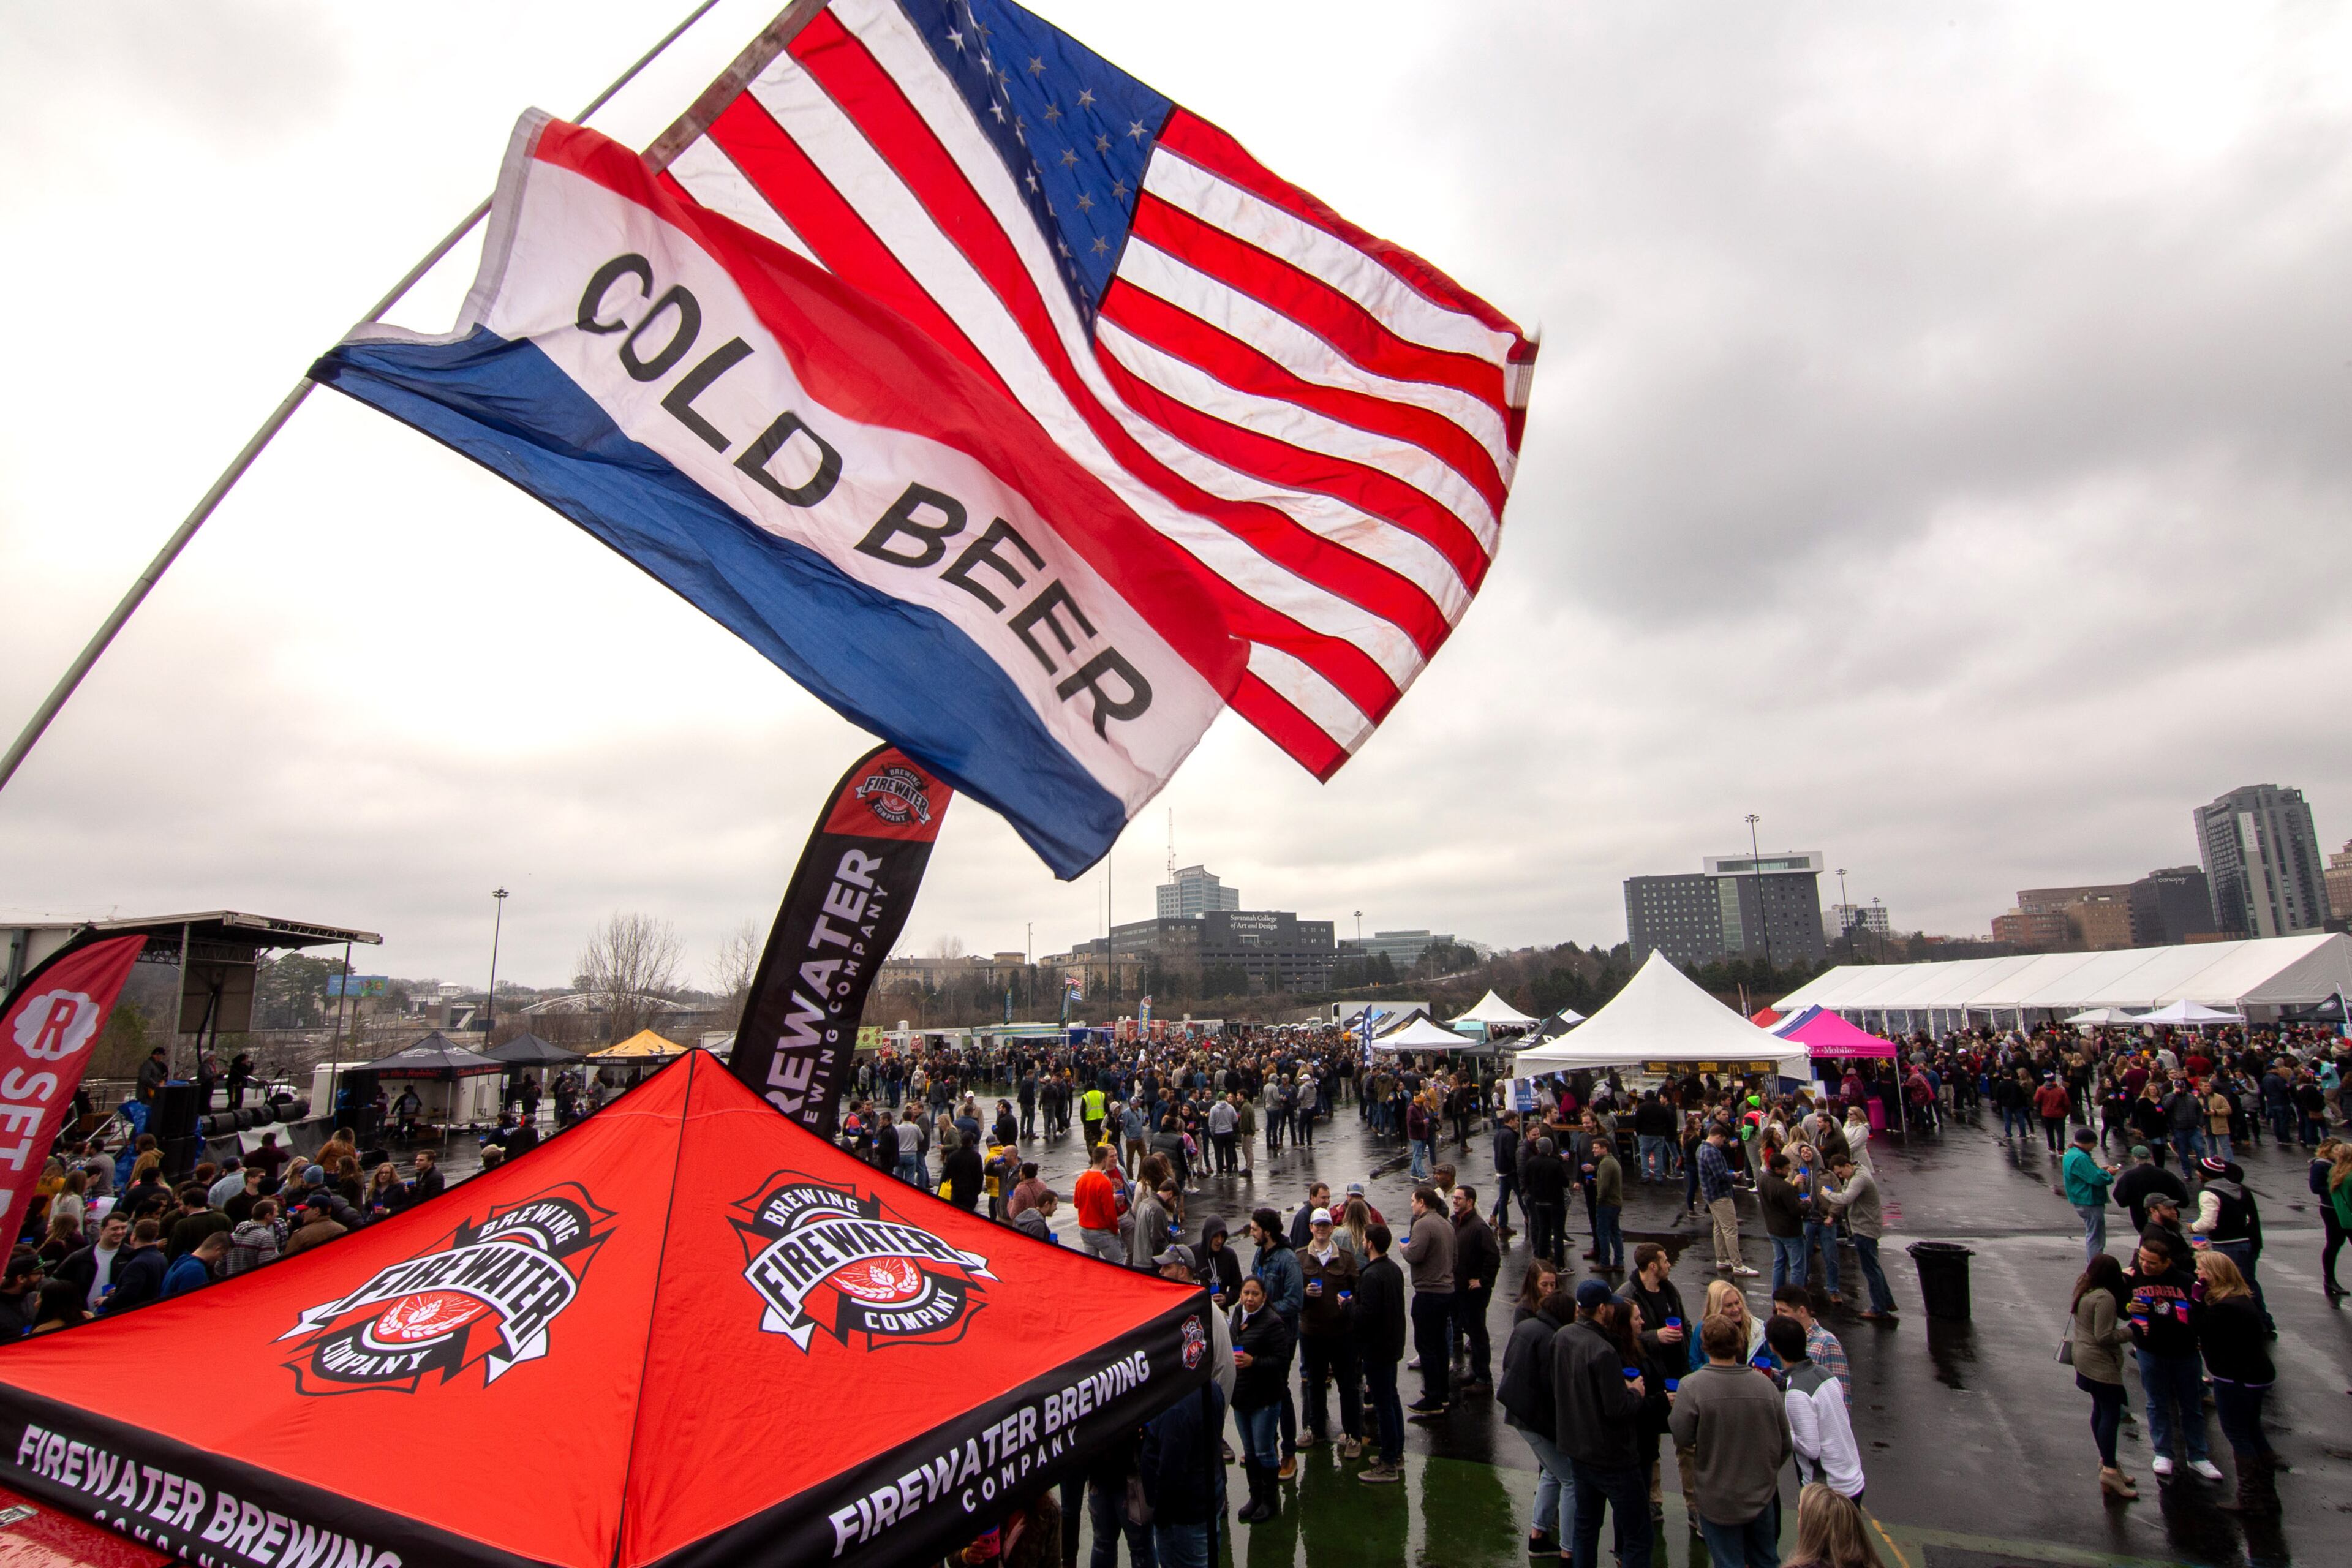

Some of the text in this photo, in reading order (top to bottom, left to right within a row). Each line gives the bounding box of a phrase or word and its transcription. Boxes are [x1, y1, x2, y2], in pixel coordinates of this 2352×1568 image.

[576, 252, 1153, 742] COLD BEER
[864, 777, 927, 815] FIREWATER
[889, 769, 921, 786] BREWING
[874, 804, 905, 822] COMPANY
[2158, 876, 2188, 885] canopy
[1257, 914, 1277, 923] College
[1259, 922, 1278, 931] Design
[829, 886, 888, 1014] COMPANY
[33, 998, 78, 1052] R
[478, 1204, 580, 1245] BREWING
[763, 1188, 860, 1228] BREWING
[752, 1222, 963, 1317] FIREWATER
[339, 1247, 567, 1343] FIREWATER
[864, 1287, 959, 1332] COMPANY
[322, 1336, 432, 1376] COMPANY
[829, 1350, 1150, 1558] FIREWATER BREWING
[963, 1425, 1077, 1513] COMPANY
[17, 1424, 206, 1532] FIREWATER
